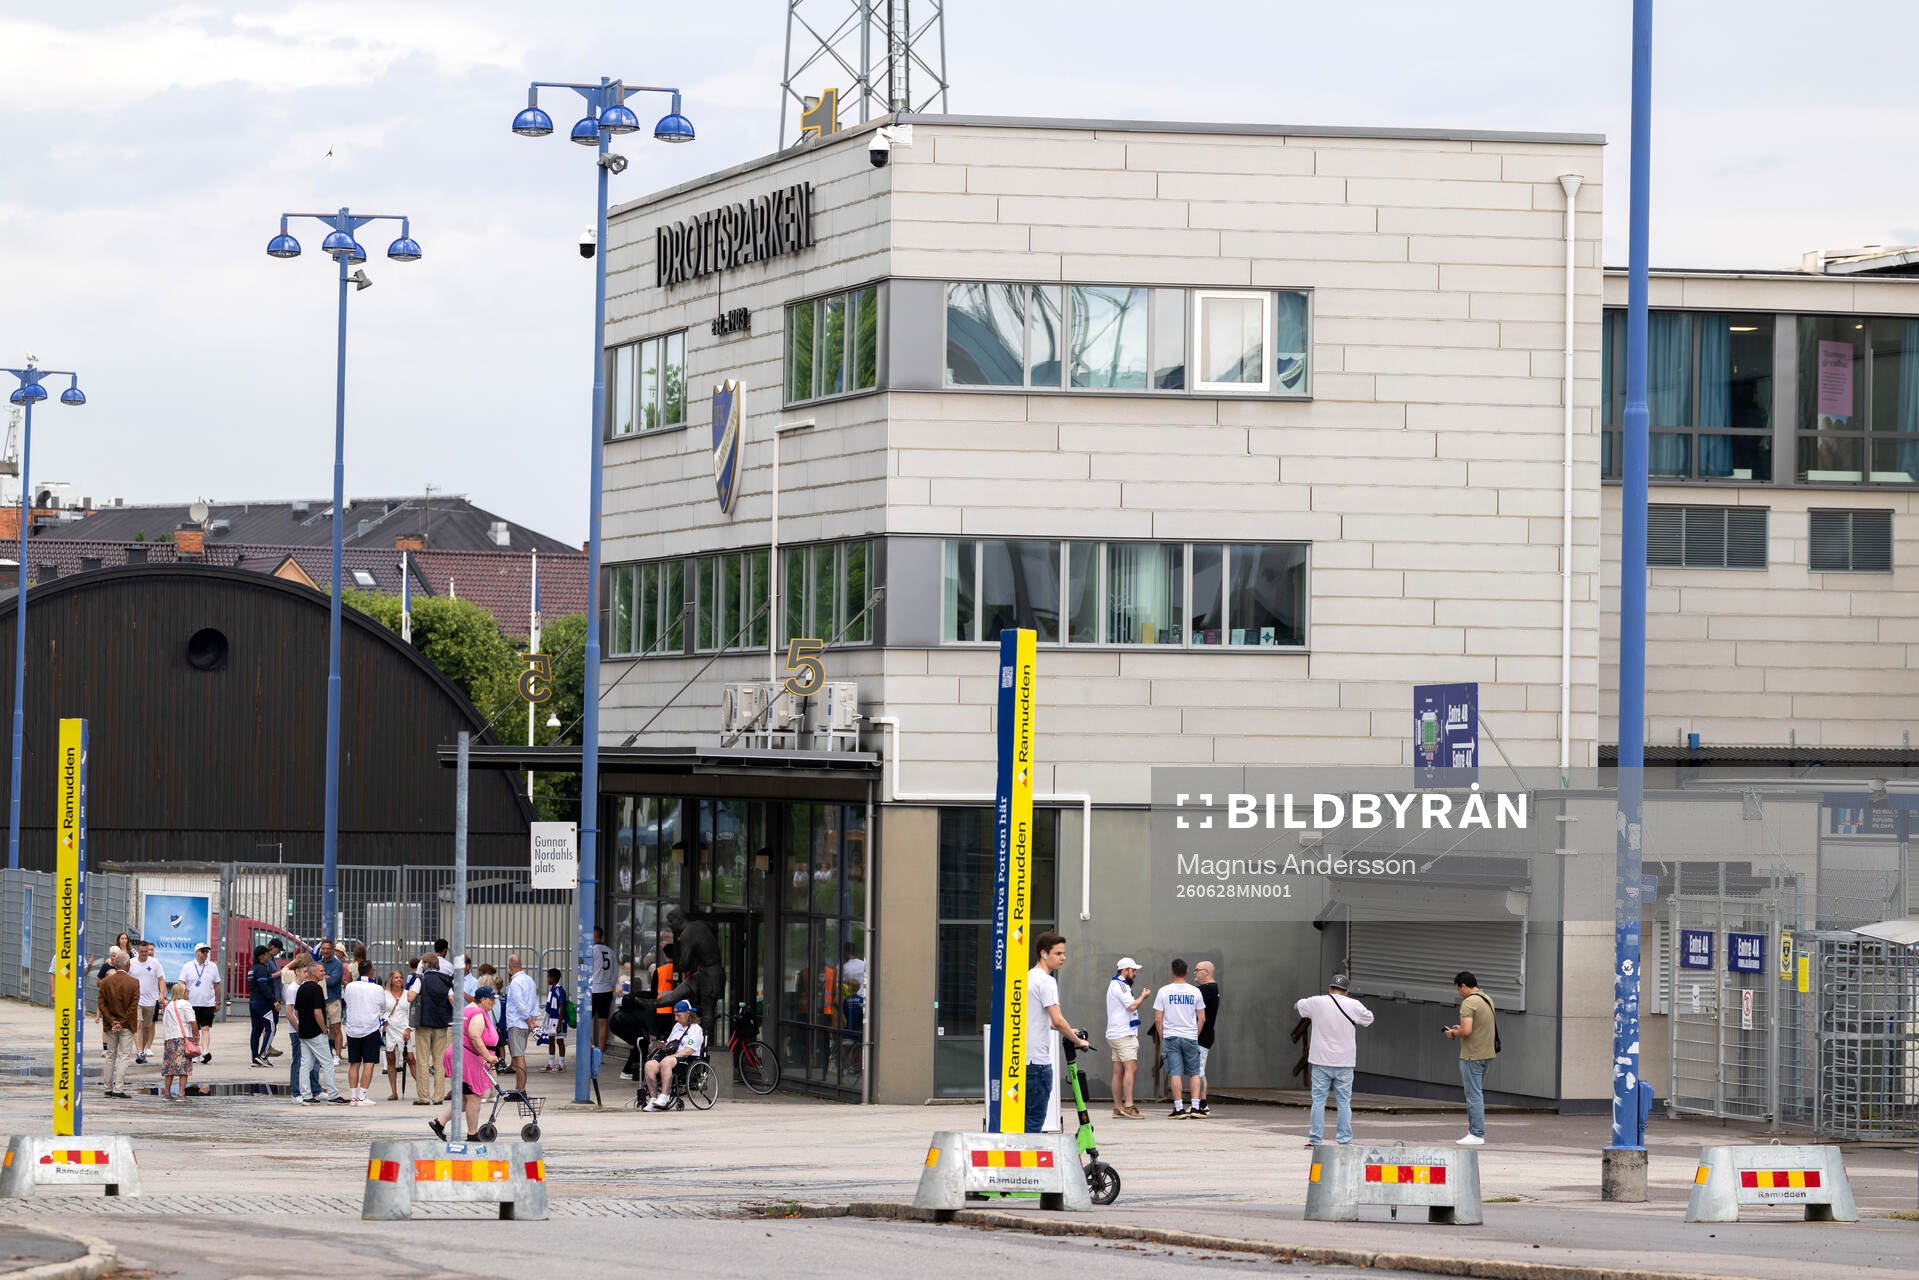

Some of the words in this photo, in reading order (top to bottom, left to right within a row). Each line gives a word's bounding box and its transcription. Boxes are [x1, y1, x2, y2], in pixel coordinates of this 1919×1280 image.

[655, 181, 811, 287] IDROTTSPARKEN
[728, 307, 748, 331] 1903
[785, 638, 826, 696] 5
[1019, 664, 1031, 763] Ramudden
[63, 747, 75, 829] Ramudden
[999, 796, 1008, 824] här
[534, 835, 567, 848] Gunnar
[534, 848, 573, 860] Nordahls
[998, 831, 1007, 882] Potten
[534, 861, 555, 876] plats
[1013, 822, 1027, 920] Ramudden
[61, 877, 73, 960] Ramudden
[996, 885, 1005, 930] Halva
[601, 951, 610, 970] 5
[995, 939, 1004, 971] Köp
[1738, 938, 1751, 957] Entré
[1168, 994, 1195, 1005] PEKING
[1009, 979, 1022, 1078] Ramudden
[59, 1008, 70, 1090] Ramudden
[55, 1167, 100, 1176] Ramudden
[988, 1176, 1040, 1185] Ramudden
